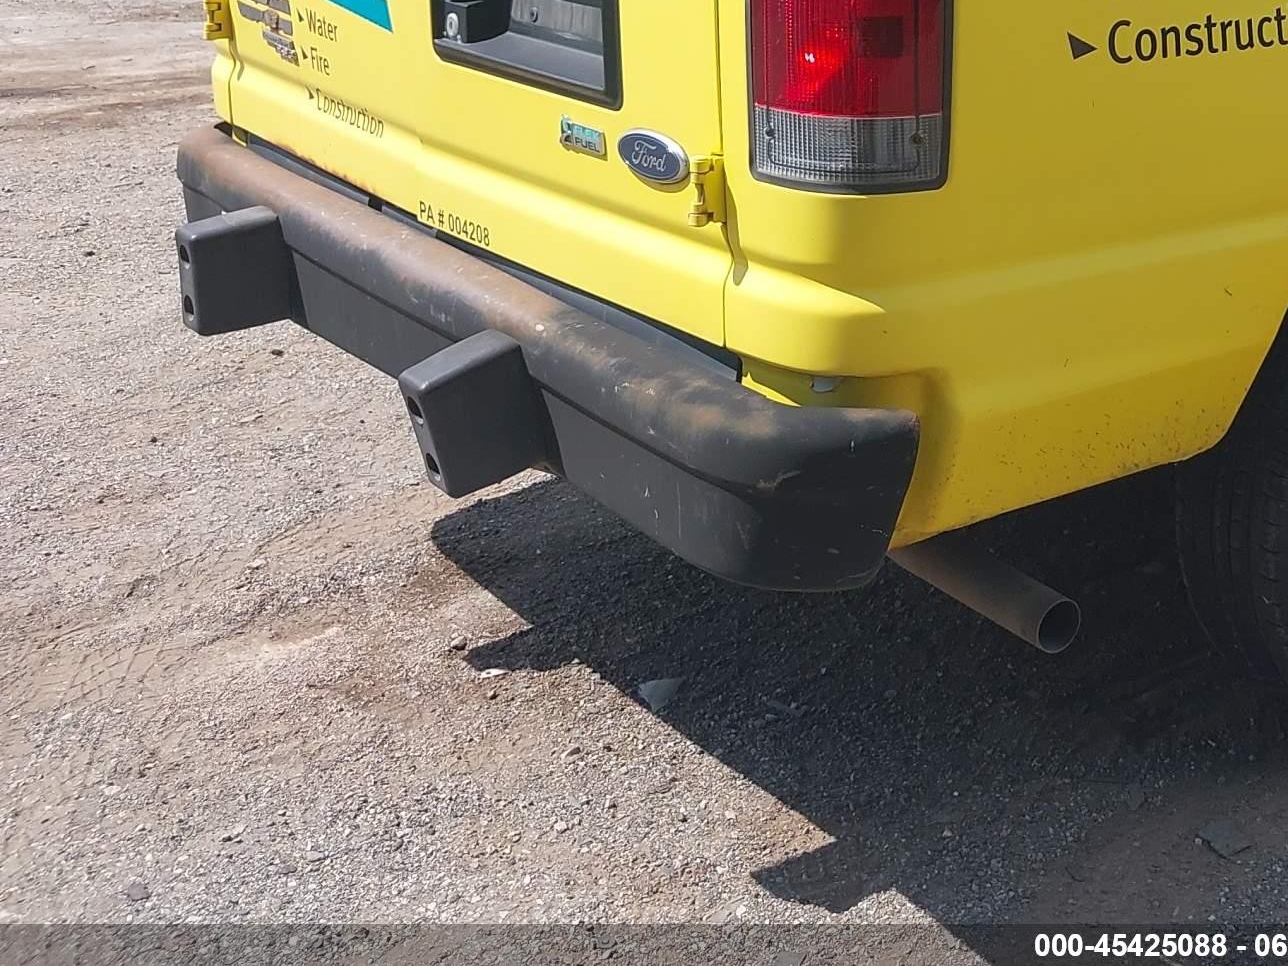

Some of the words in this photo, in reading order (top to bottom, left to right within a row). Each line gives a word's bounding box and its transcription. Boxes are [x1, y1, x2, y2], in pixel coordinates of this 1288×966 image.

[305, 8, 338, 43] Water
[310, 46, 330, 76] Fire
[315, 88, 385, 139] Construction
[574, 136, 601, 153] FUEL
[631, 139, 667, 173] Ford
[419, 200, 435, 224] PA
[448, 213, 491, 247] 004208
